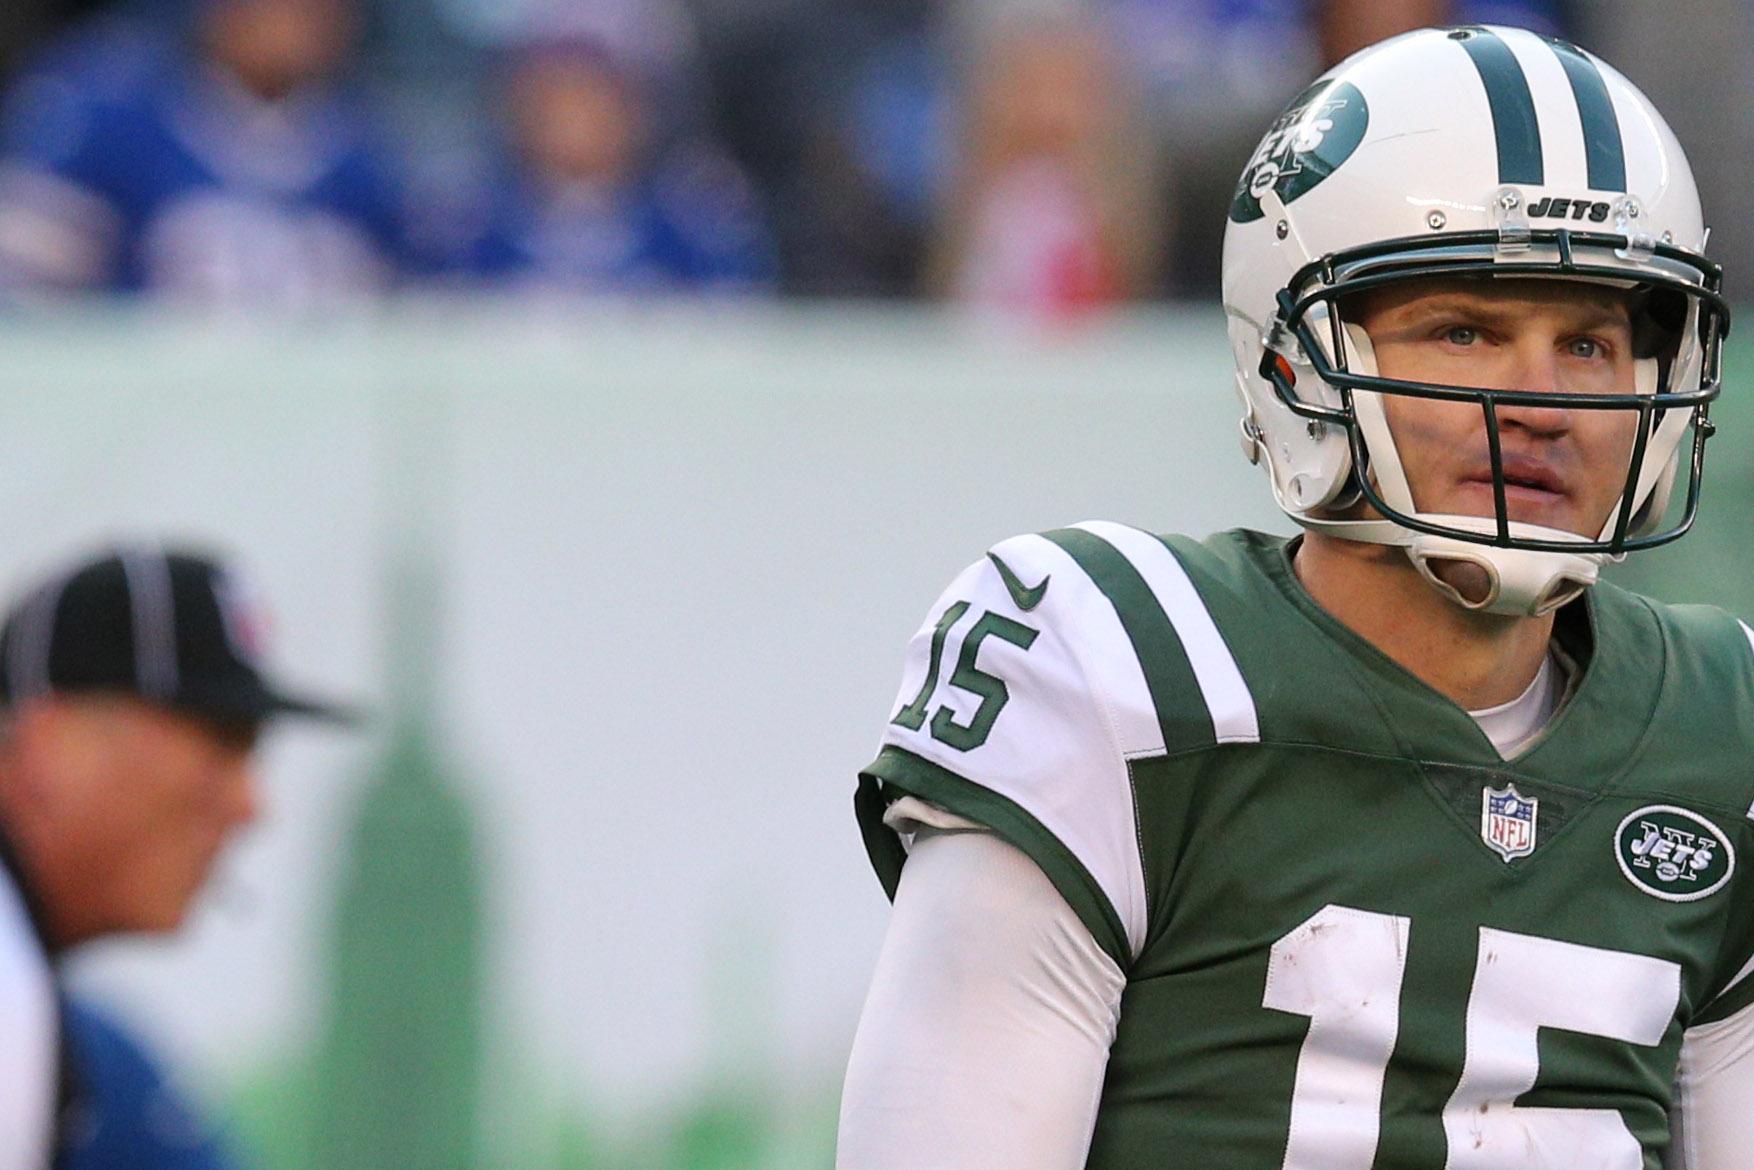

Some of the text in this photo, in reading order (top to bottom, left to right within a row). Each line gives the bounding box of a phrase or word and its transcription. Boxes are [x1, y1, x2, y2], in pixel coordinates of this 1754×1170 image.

[1527, 197, 1610, 223] JETS
[890, 600, 1040, 752] 15
[1492, 815, 1527, 848] NFL
[1630, 831, 1713, 870] JETS
